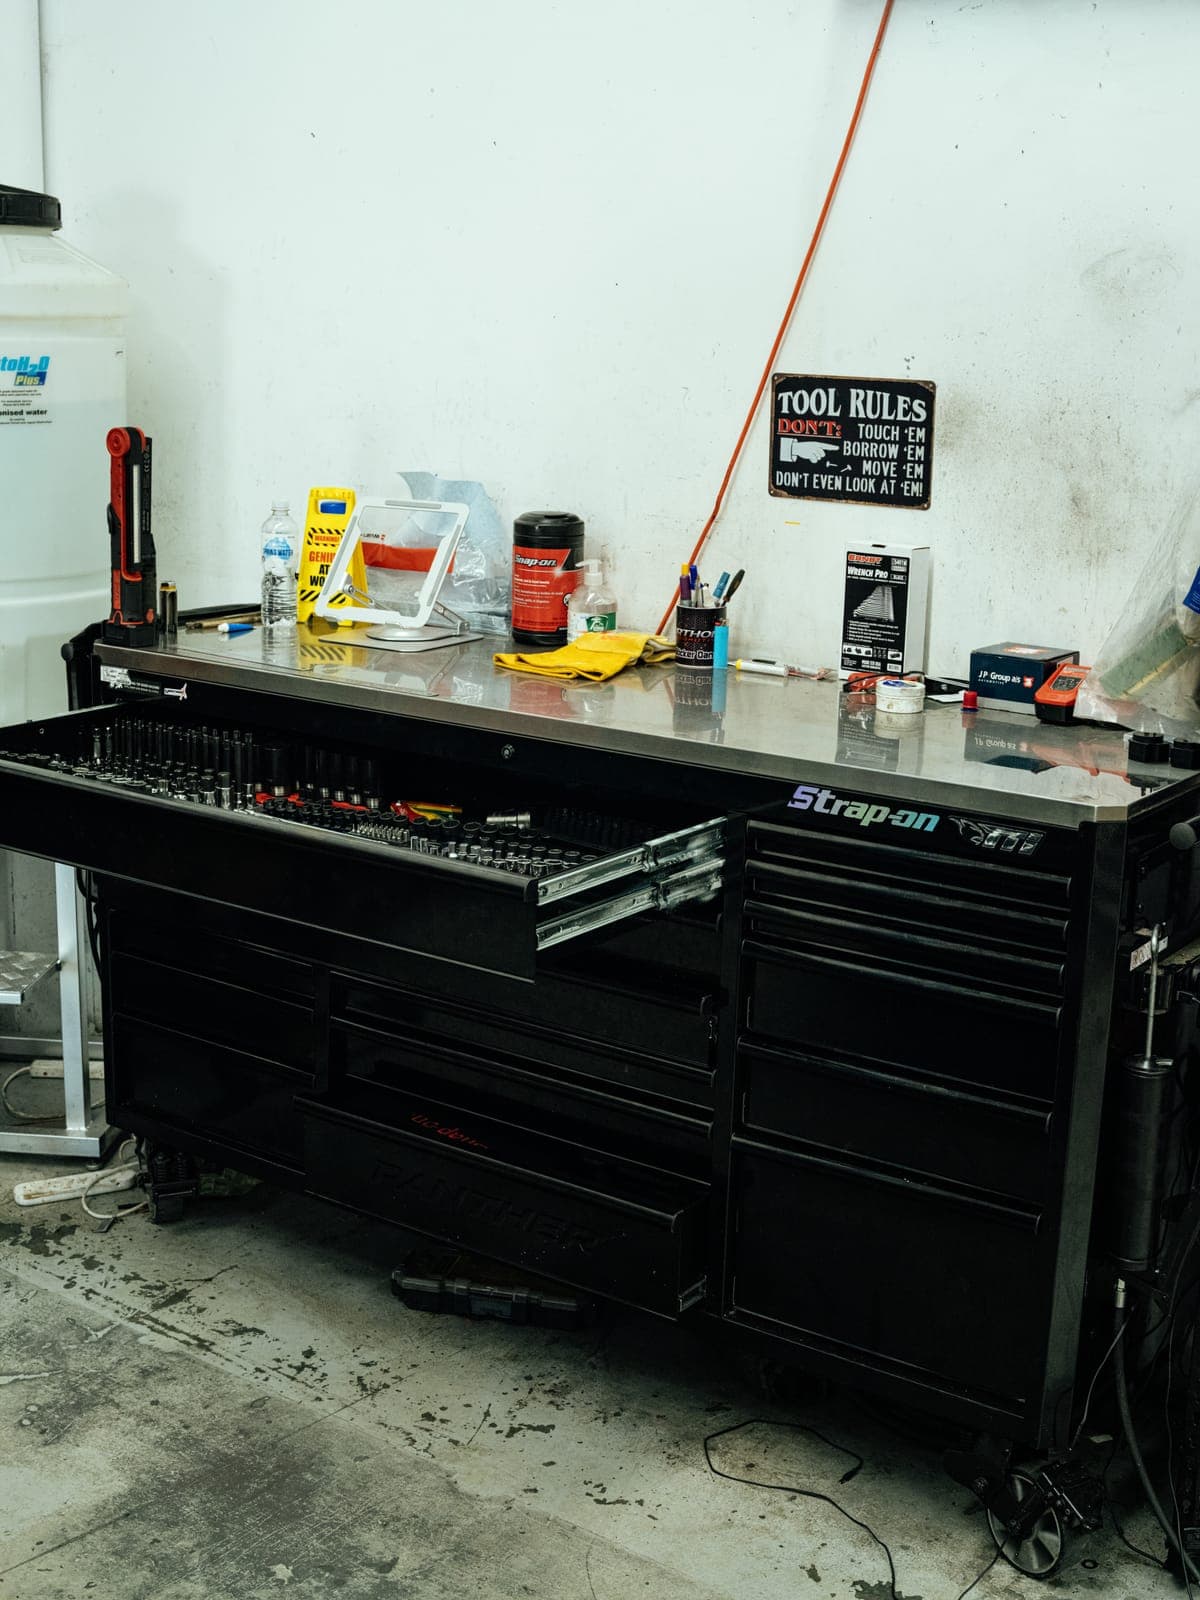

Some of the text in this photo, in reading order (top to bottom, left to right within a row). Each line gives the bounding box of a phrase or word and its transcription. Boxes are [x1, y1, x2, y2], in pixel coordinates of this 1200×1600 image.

[15, 375, 40, 385] Plus
[778, 388, 927, 422] TOOL RULES
[777, 418, 842, 437] DON'T:
[857, 423, 926, 443] TOUCH 'EM
[843, 440, 925, 462] BORROW 'EM
[862, 459, 924, 479] MOVE 'EM
[776, 470, 923, 497] DON'T EVEN LOOK AT 'EM!
[319, 564, 330, 575] AT
[514, 553, 557, 567] Snap-on
[990, 671, 1011, 684] Group
[787, 785, 940, 833] Strap-on
